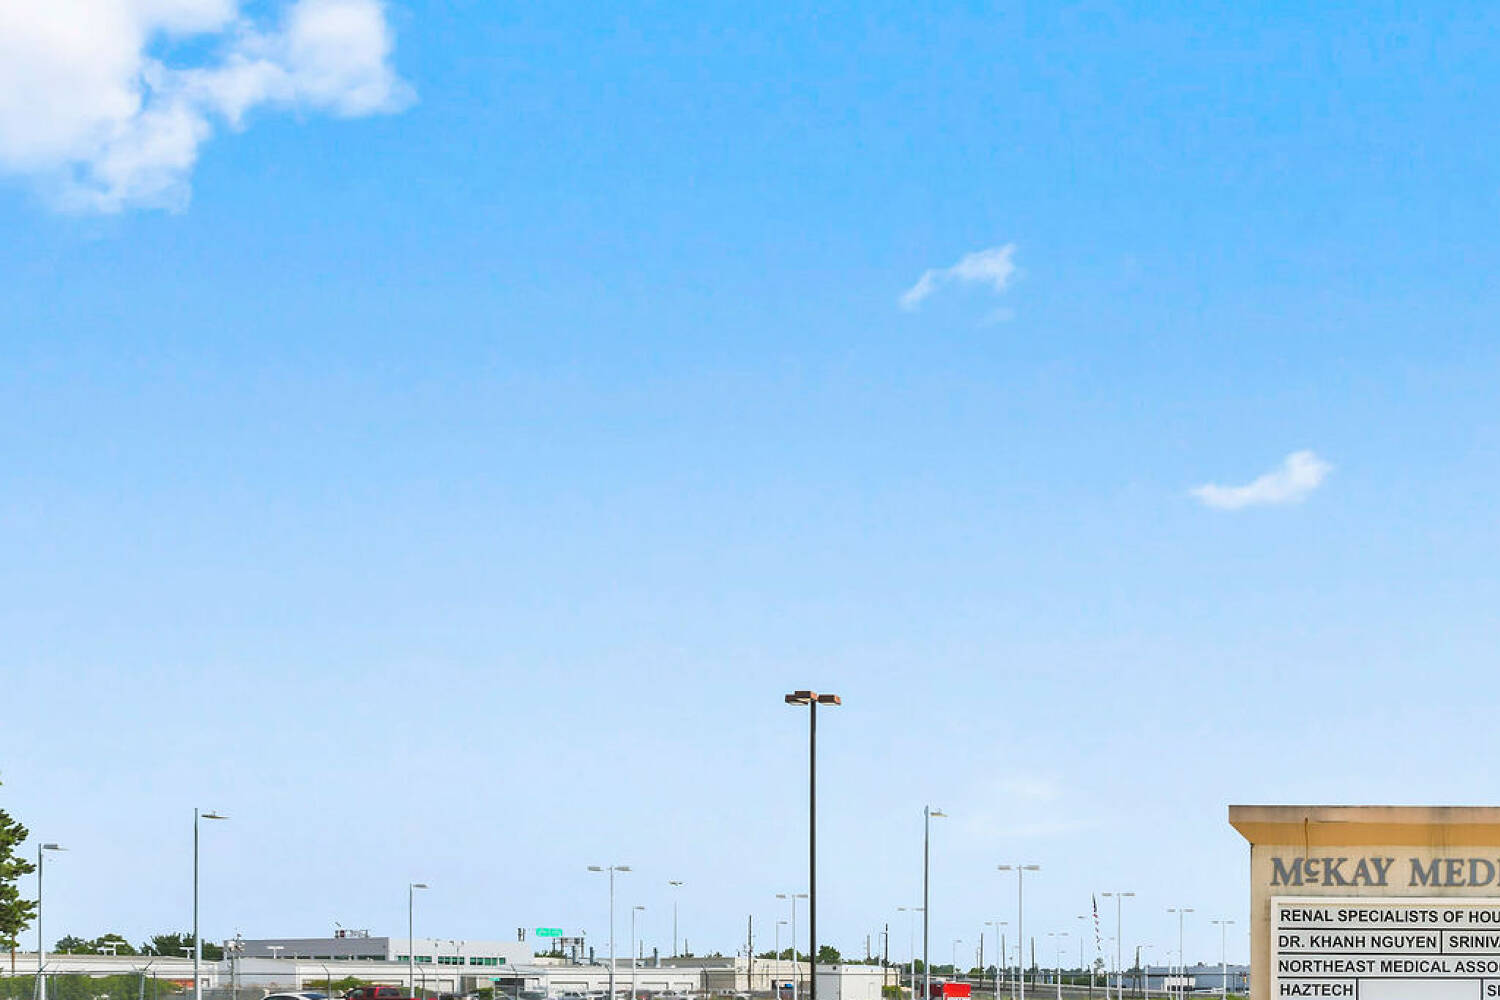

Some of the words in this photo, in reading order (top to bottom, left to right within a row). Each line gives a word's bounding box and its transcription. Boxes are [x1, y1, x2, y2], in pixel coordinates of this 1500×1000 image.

[1280, 909, 1334, 922] RENAL
[1338, 909, 1439, 923] SPECIALISTS
[1443, 910, 1464, 923] OF
[1279, 935, 1305, 948] DR.
[1310, 936, 1366, 948] KHANH
[1371, 936, 1437, 949] NGUYEN
[1279, 960, 1376, 973] NORTHEAST
[1380, 961, 1450, 973] MEDICAL
[1279, 984, 1354, 997] HAZTECH
